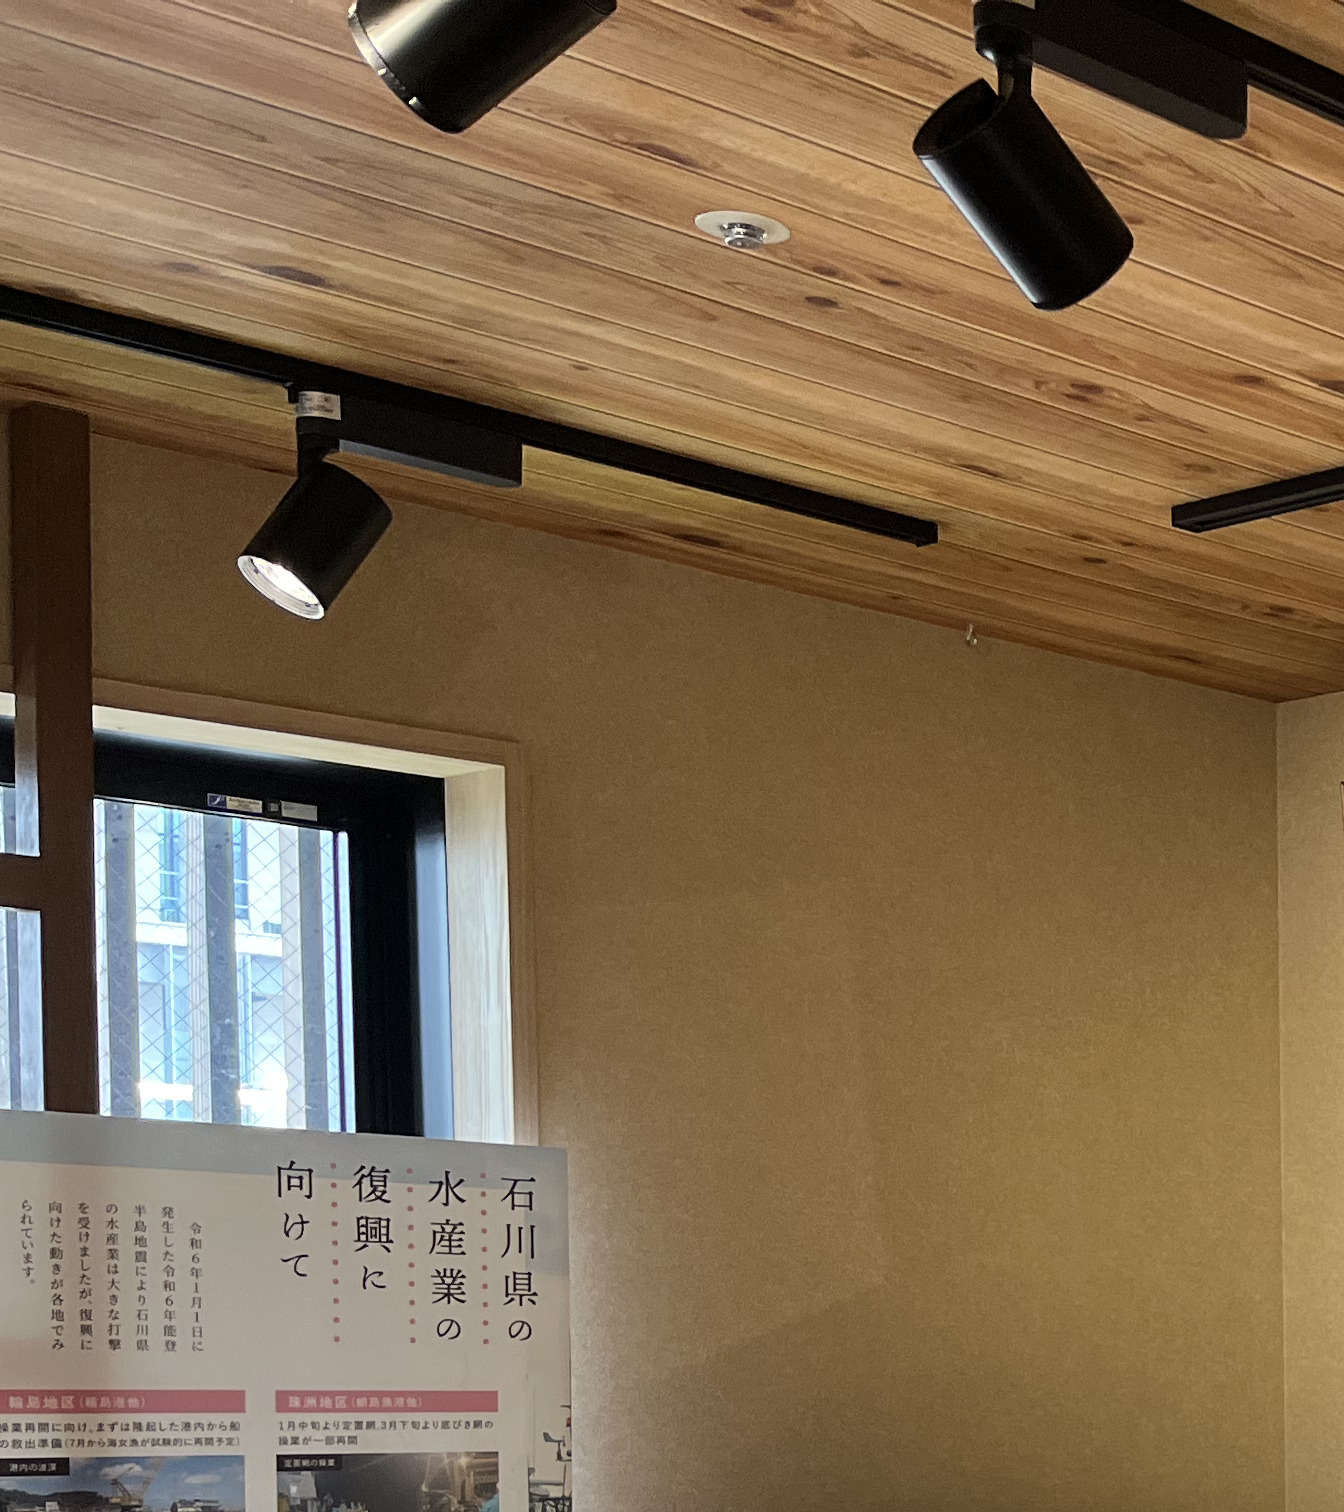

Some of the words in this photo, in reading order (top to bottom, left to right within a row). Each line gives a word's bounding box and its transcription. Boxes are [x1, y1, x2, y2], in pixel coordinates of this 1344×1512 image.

[20, 1199, 36, 1285] られています。
[276, 1160, 314, 1280] 向けて
[353, 1164, 394, 1291] 復興に
[429, 1170, 468, 1342] 水産業の
[501, 1175, 539, 1343] 石川県の
